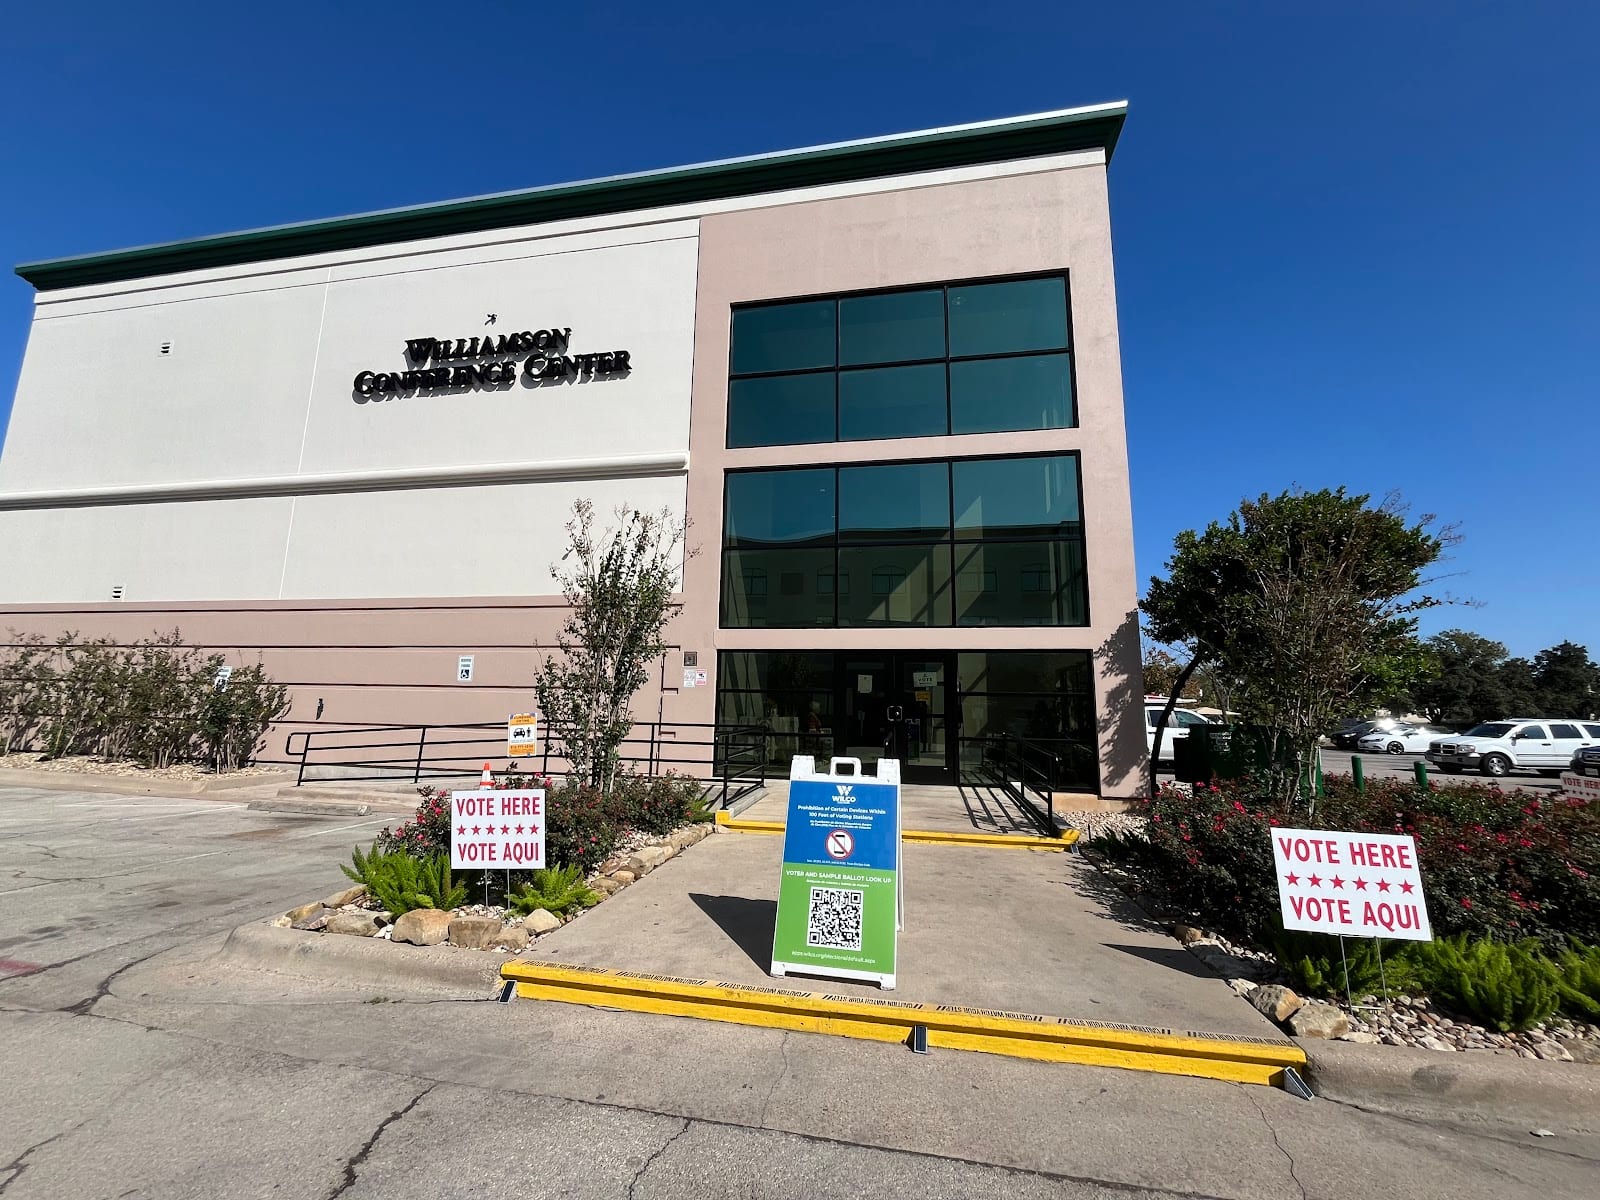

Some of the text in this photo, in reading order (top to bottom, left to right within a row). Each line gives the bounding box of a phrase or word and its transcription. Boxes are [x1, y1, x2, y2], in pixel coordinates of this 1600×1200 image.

[404, 328, 571, 362] WILLIAMSON
[353, 350, 631, 395] CONFERENCE CENTER
[1562, 776, 1600, 790] VOTE HER
[456, 796, 540, 816] VOTE HERE
[832, 795, 856, 803] WILCO
[458, 842, 539, 865] VOTE AQUI
[1278, 838, 1412, 869] VOTE HERE
[818, 872, 841, 880] SAMPLE
[1289, 896, 1421, 932] VOTE AQUI
[981, 1010, 1004, 1018] WATCH
